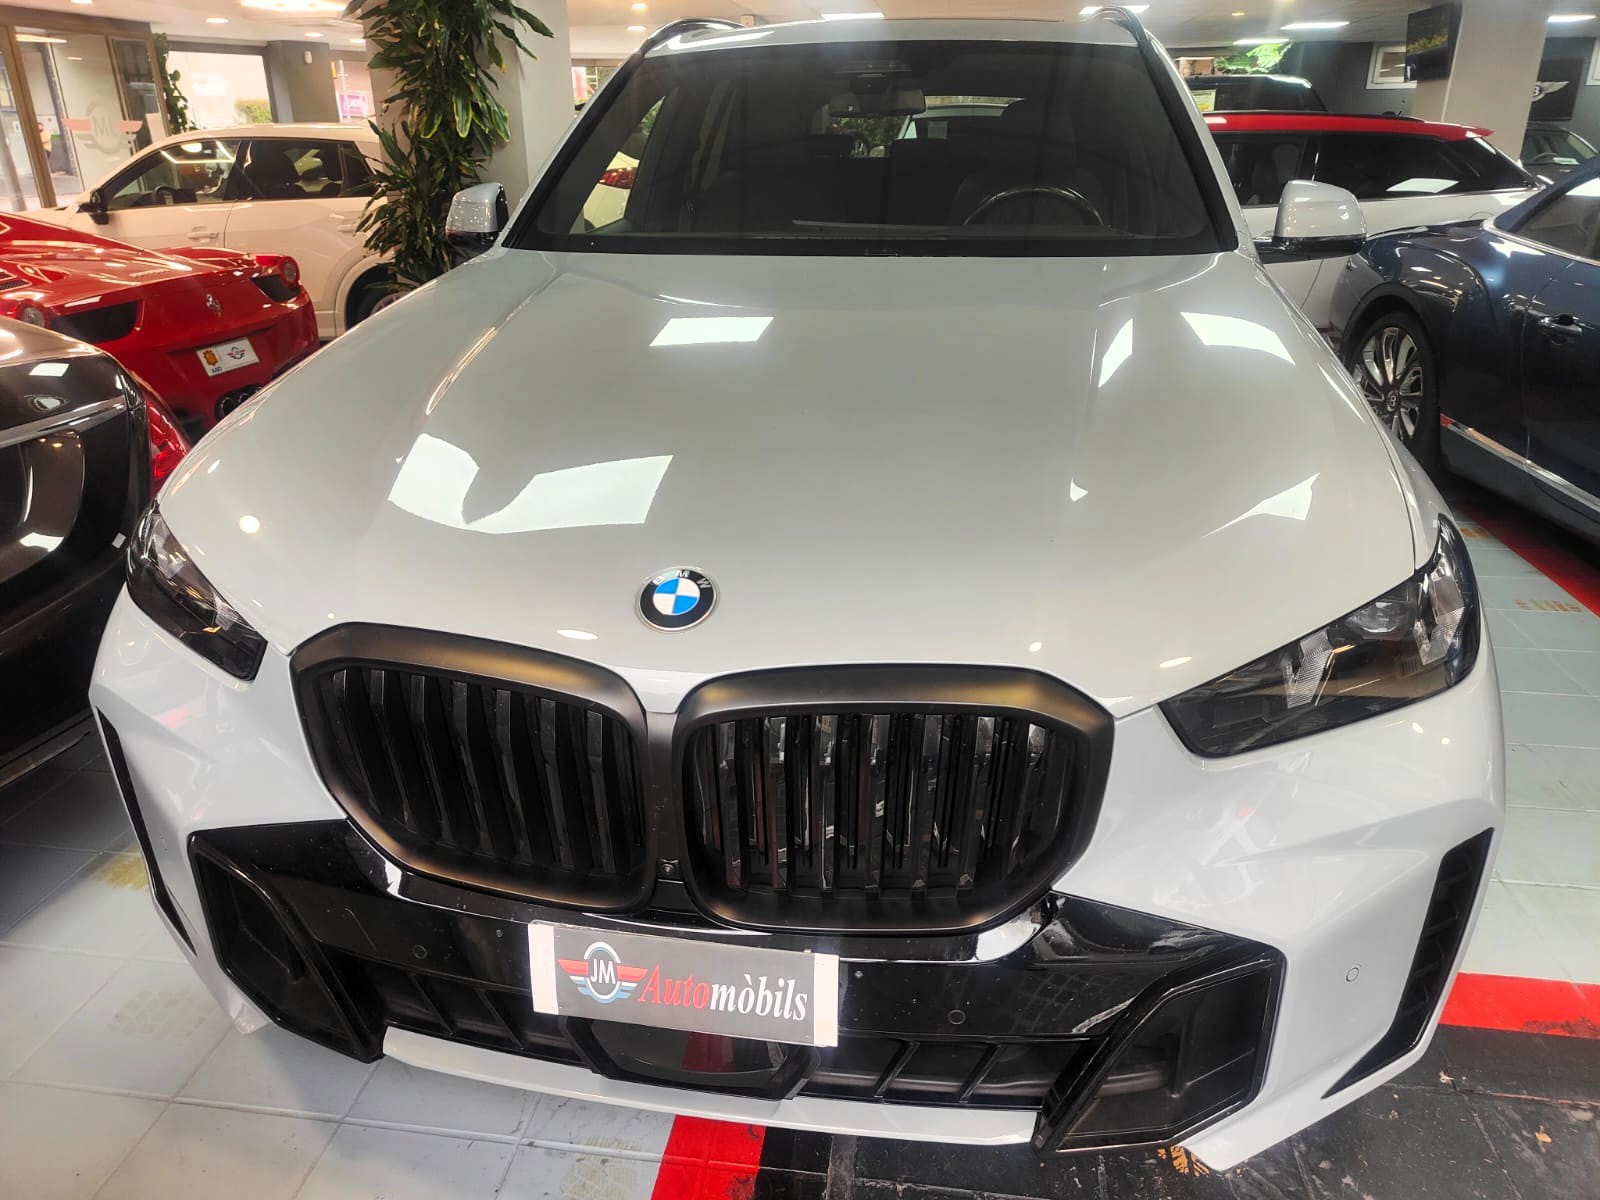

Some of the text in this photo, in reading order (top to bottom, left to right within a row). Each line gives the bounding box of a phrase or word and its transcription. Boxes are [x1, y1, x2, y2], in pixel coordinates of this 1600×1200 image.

[652, 570, 711, 589] BMW
[590, 959, 808, 1021] JM Automòbils
